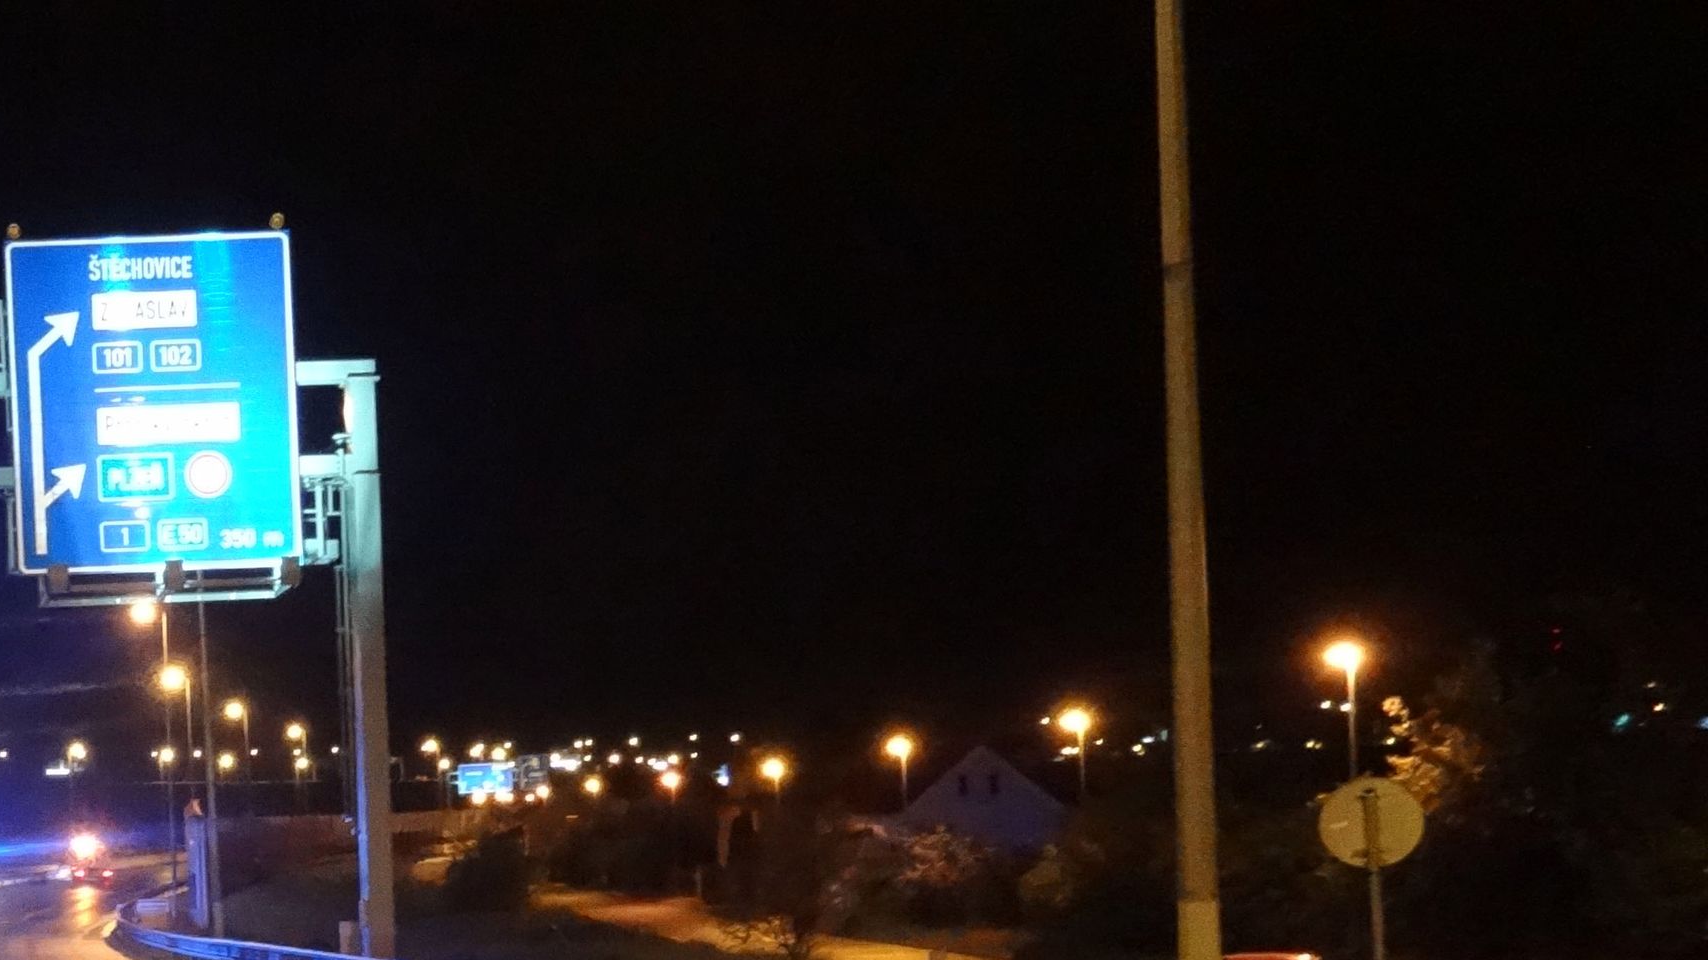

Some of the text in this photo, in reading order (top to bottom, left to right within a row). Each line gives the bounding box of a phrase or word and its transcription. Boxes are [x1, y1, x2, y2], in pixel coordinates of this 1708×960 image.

[100, 300, 188, 322] ZASLAV
[103, 347, 133, 368] 101
[158, 345, 193, 366] 102
[120, 527, 130, 546] 1
